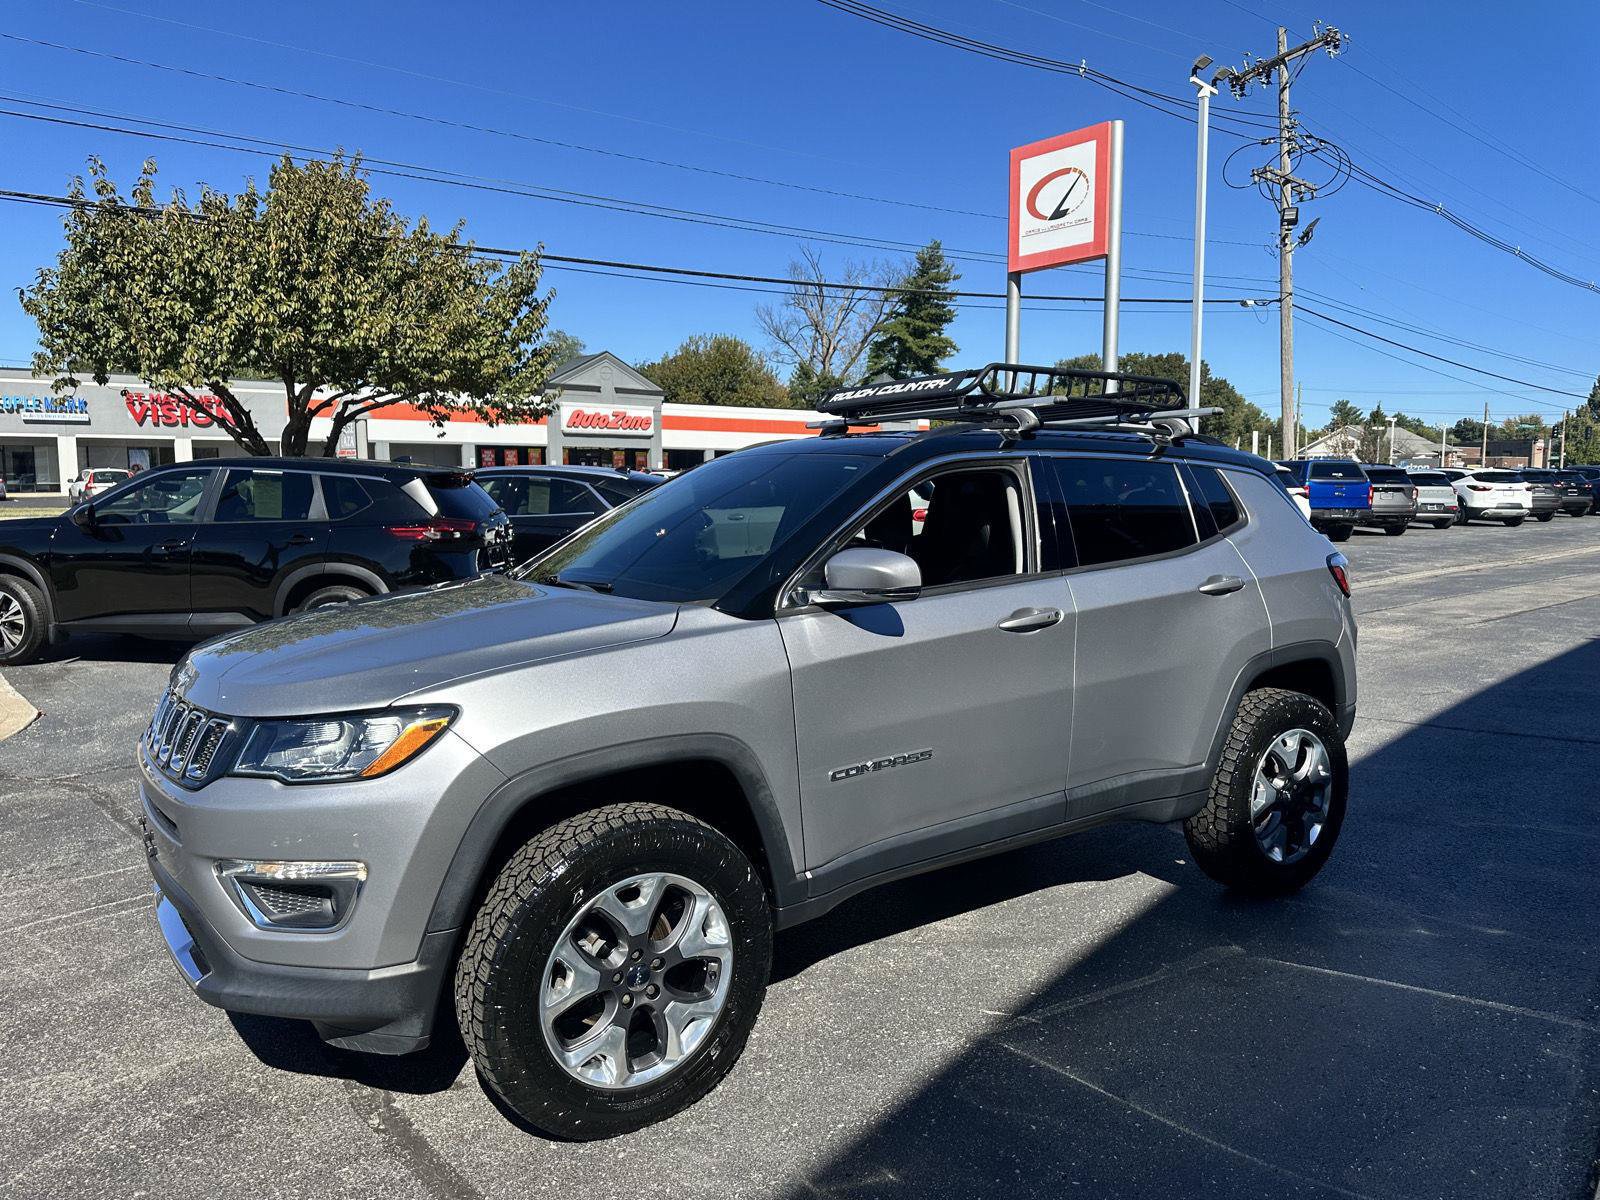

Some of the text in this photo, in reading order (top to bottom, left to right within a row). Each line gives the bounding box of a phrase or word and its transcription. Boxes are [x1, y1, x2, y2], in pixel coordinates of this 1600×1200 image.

[0, 394, 41, 410] OPLE
[829, 377, 954, 403] ROUGH COUNTRY
[566, 409, 652, 431] AutoZone
[829, 749, 933, 782] COMPASS
